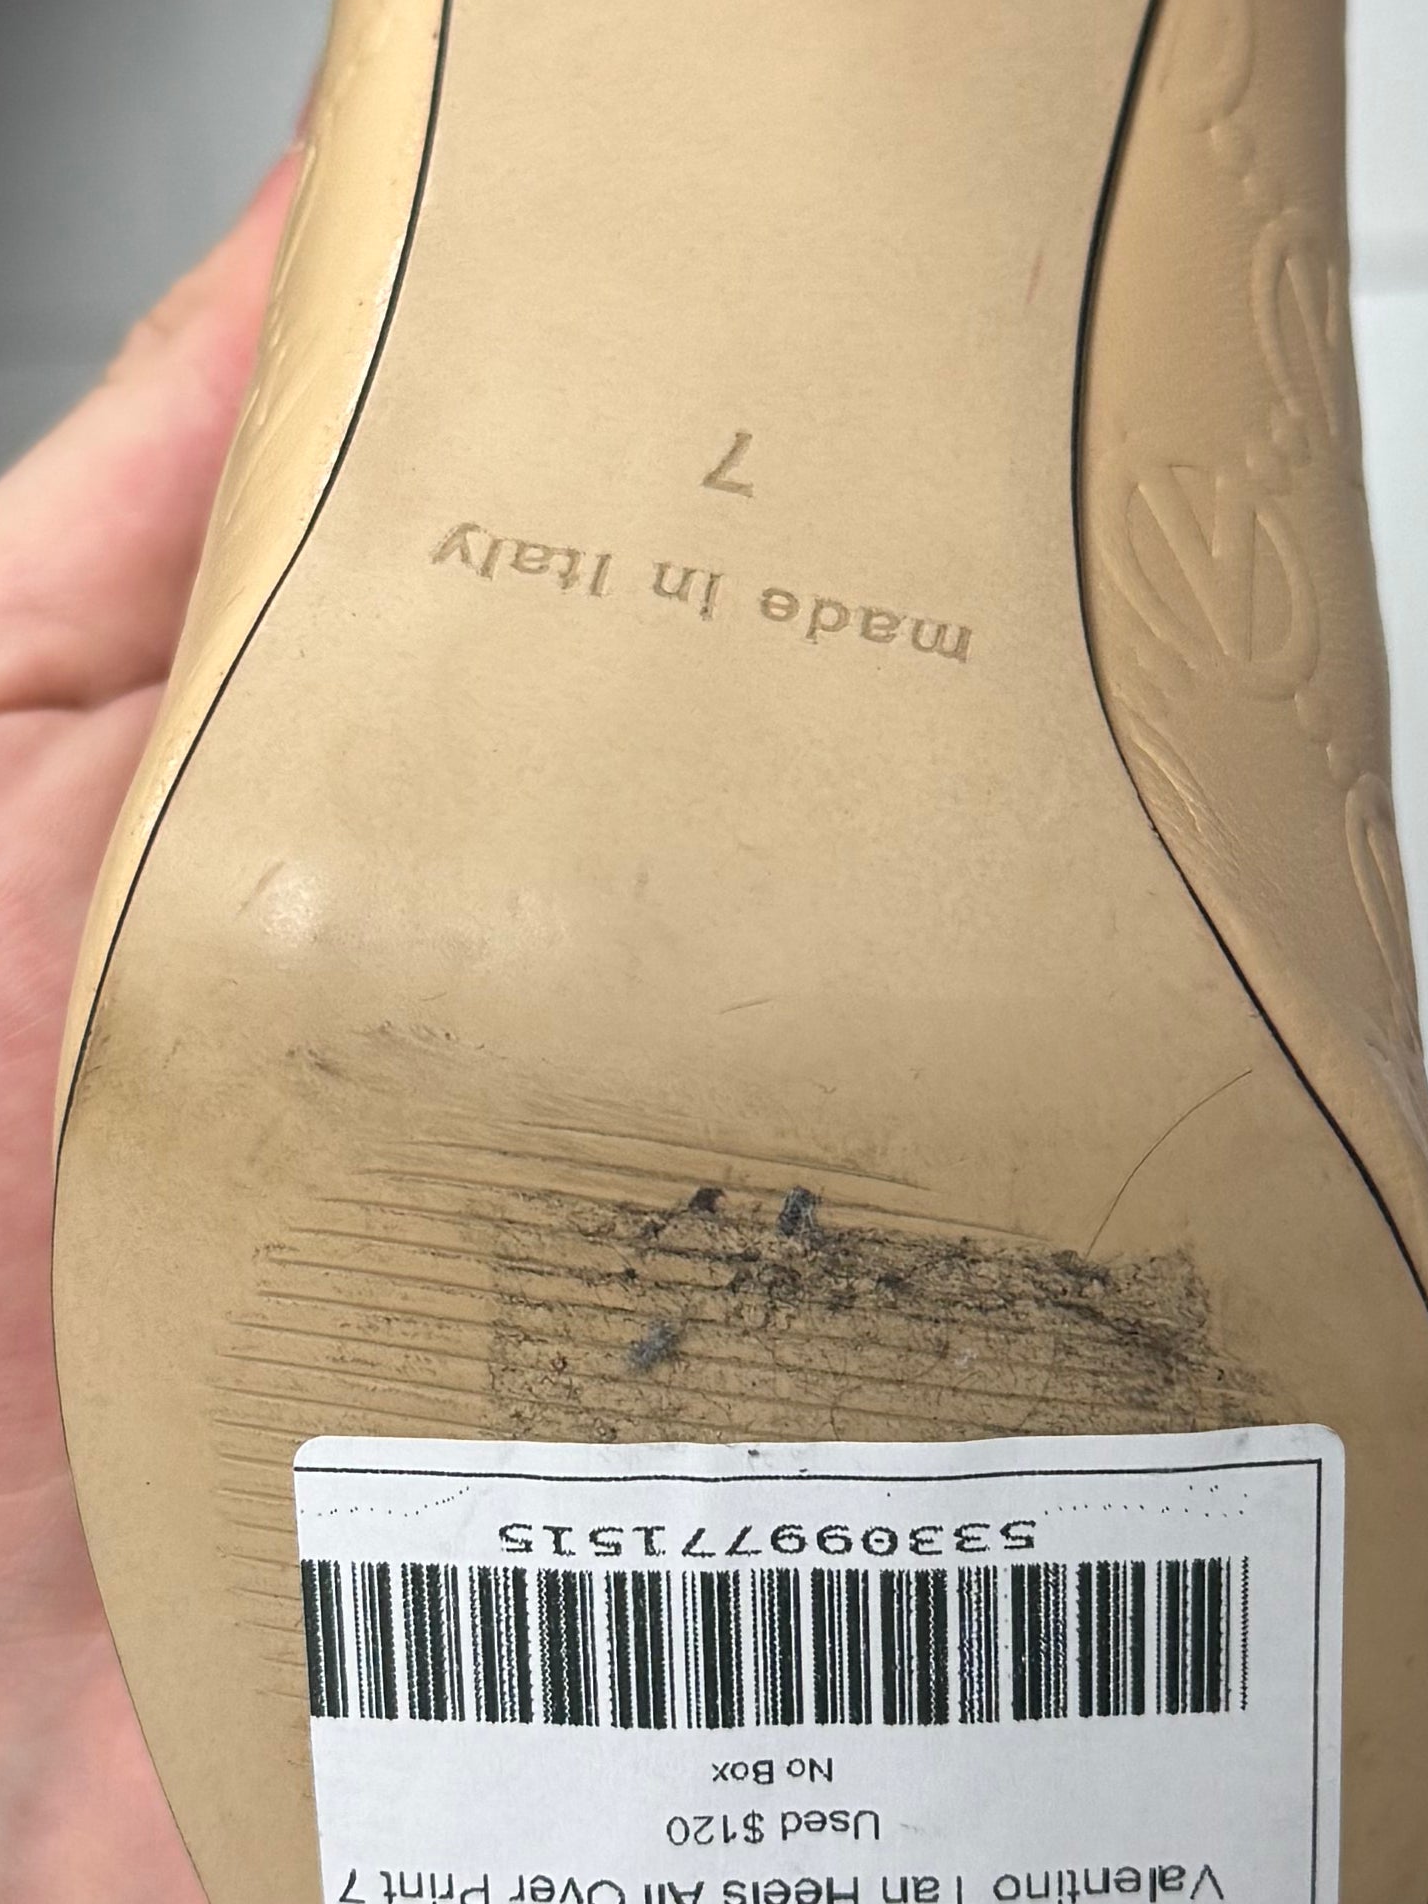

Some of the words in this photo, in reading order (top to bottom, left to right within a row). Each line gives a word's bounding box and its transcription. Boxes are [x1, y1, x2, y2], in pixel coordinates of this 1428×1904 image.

[700, 432, 755, 499] 7
[429, 522, 613, 601] Italy
[651, 561, 726, 623] in
[760, 586, 973, 665] made
[498, 1519, 1037, 1557] 533099771515
[711, 1759, 775, 1786] Box
[786, 1757, 833, 1783] No
[666, 1809, 765, 1846] $120
[780, 1809, 880, 1842] Used
[338, 1868, 366, 1904] 7
